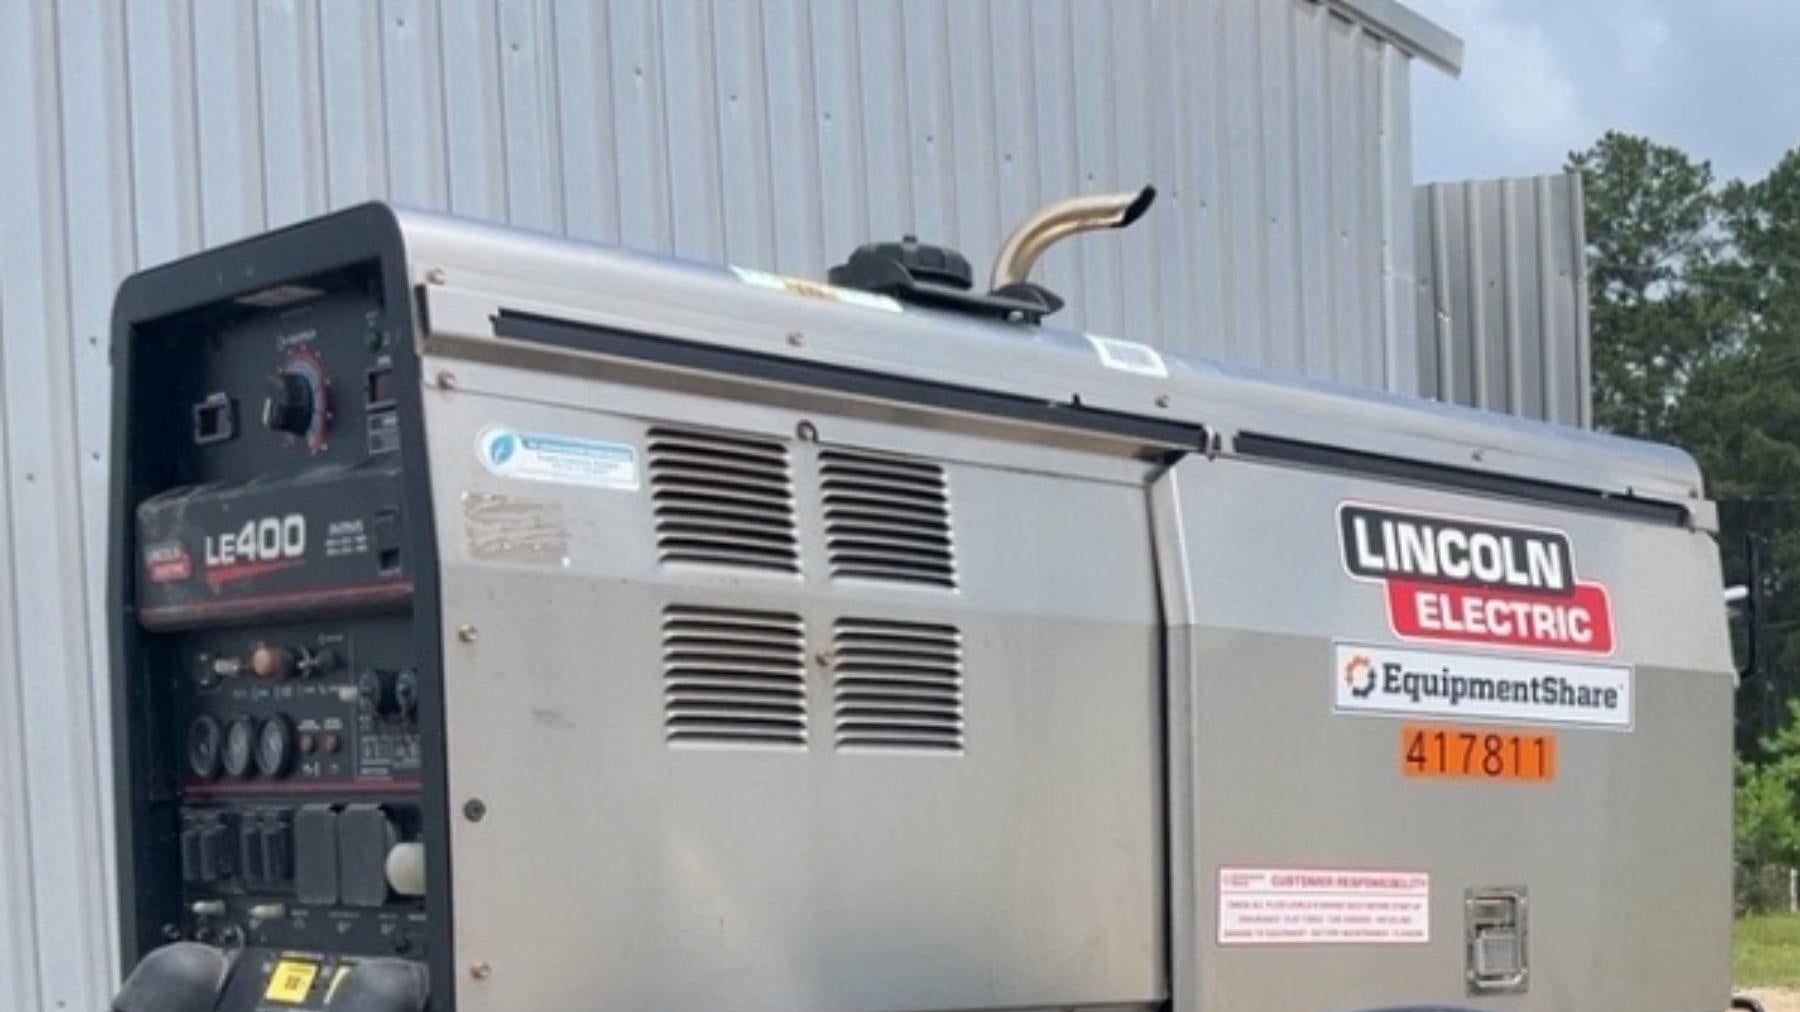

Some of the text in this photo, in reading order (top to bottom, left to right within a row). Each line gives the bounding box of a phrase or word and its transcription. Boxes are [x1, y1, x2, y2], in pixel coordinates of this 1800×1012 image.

[205, 514, 306, 566] LE400
[1353, 515, 1565, 589] LINCOLN
[1415, 591, 1593, 644] ELECTRIC
[1382, 662, 1618, 709] EquipmentShare
[1406, 731, 1547, 778] 417811
